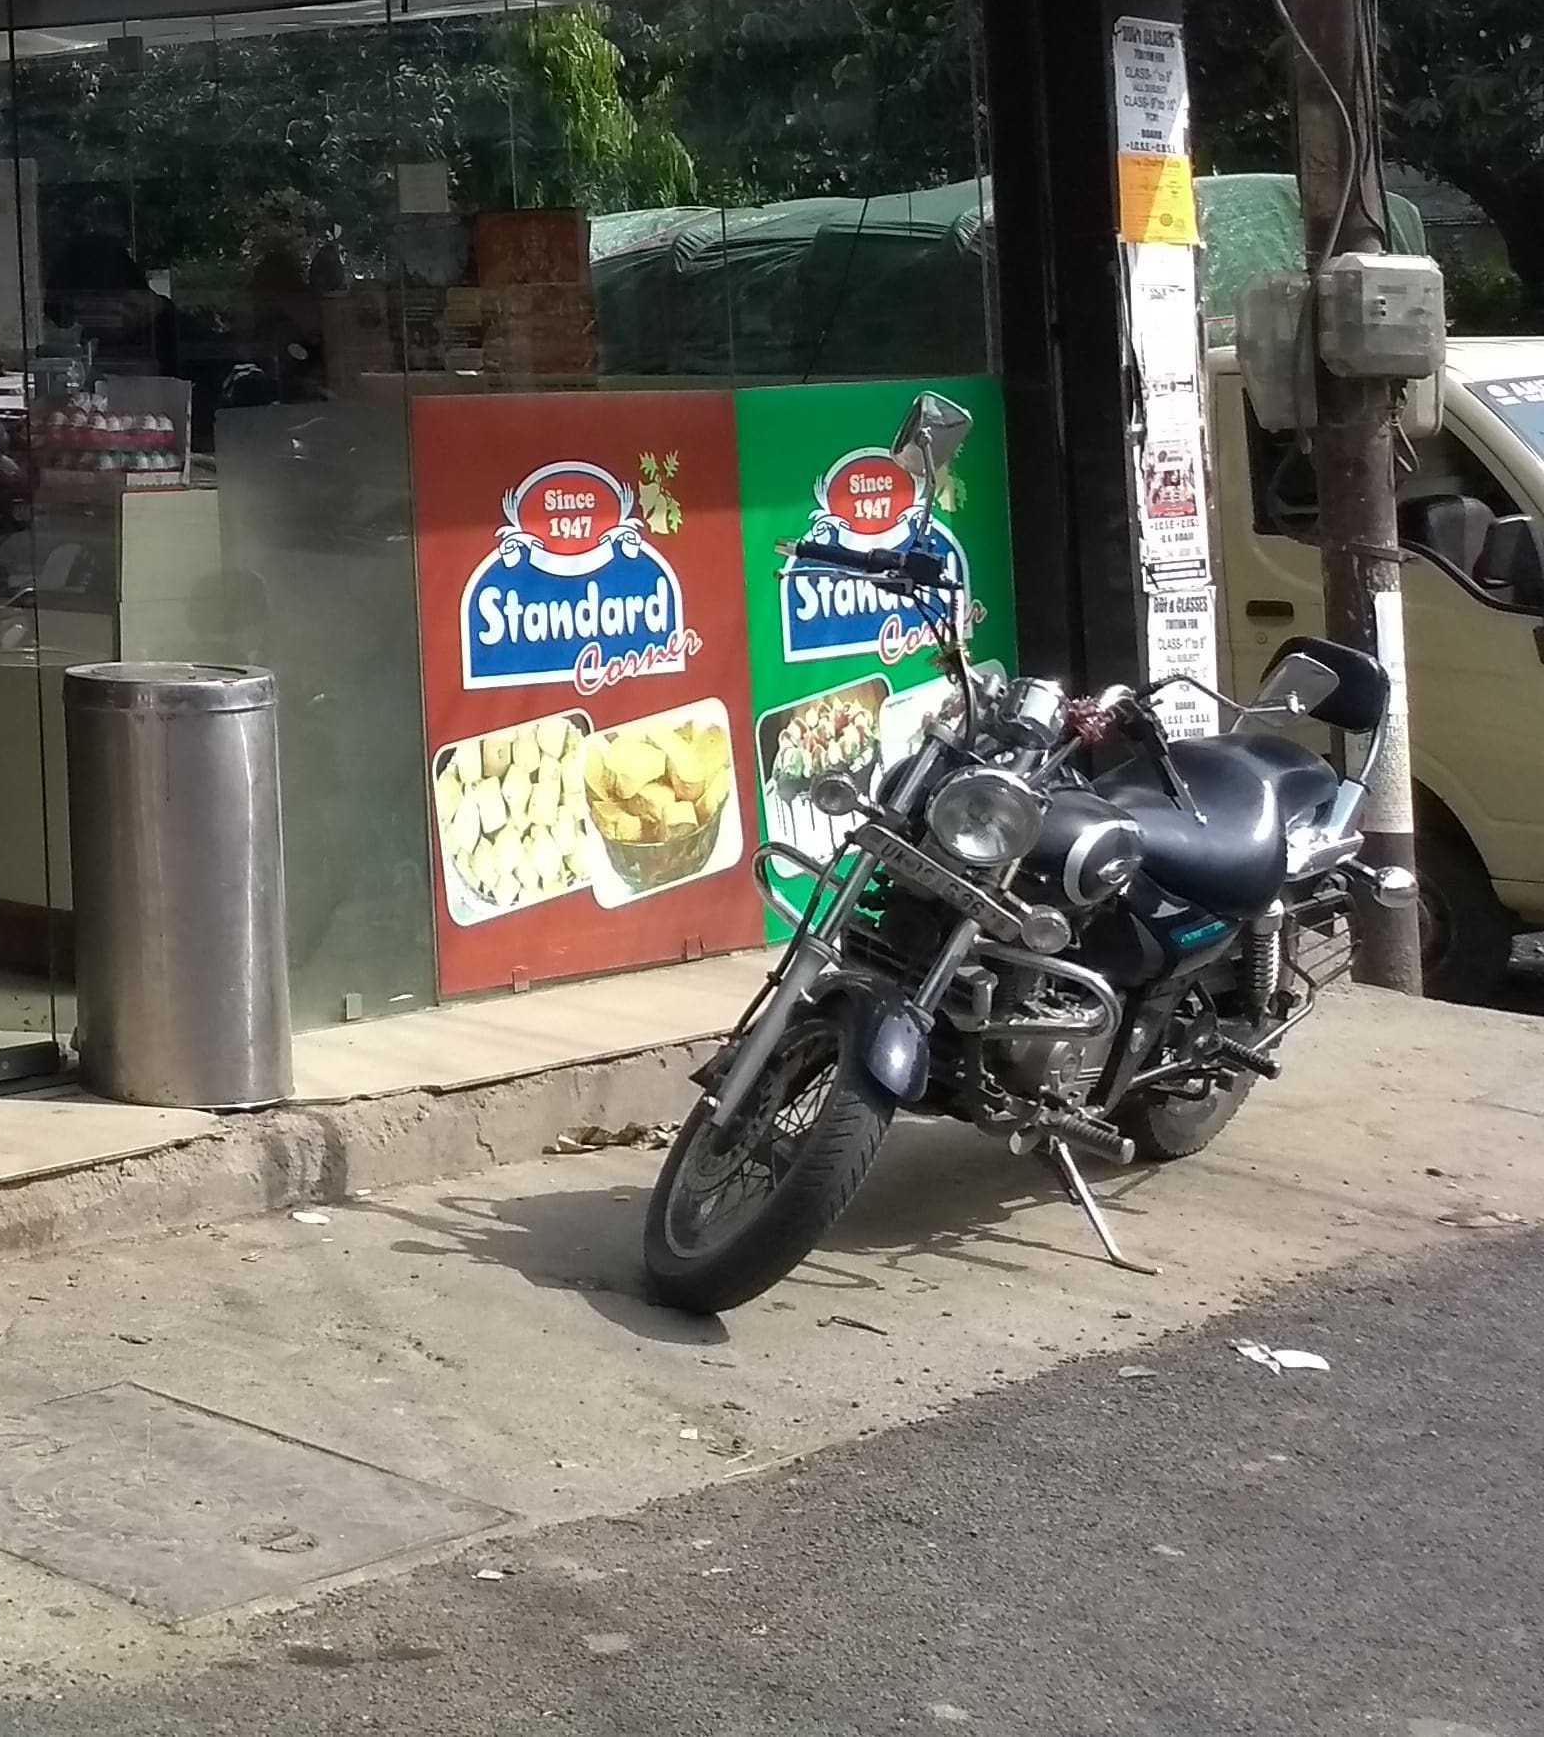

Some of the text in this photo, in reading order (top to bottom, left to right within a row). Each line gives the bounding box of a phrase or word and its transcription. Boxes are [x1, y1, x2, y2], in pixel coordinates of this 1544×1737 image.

[848, 471, 894, 495] Since
[544, 488, 596, 512] Since
[853, 496, 892, 520] 1947
[549, 516, 592, 540] 1947
[478, 578, 669, 646] Standard
[573, 626, 703, 696] Corner
